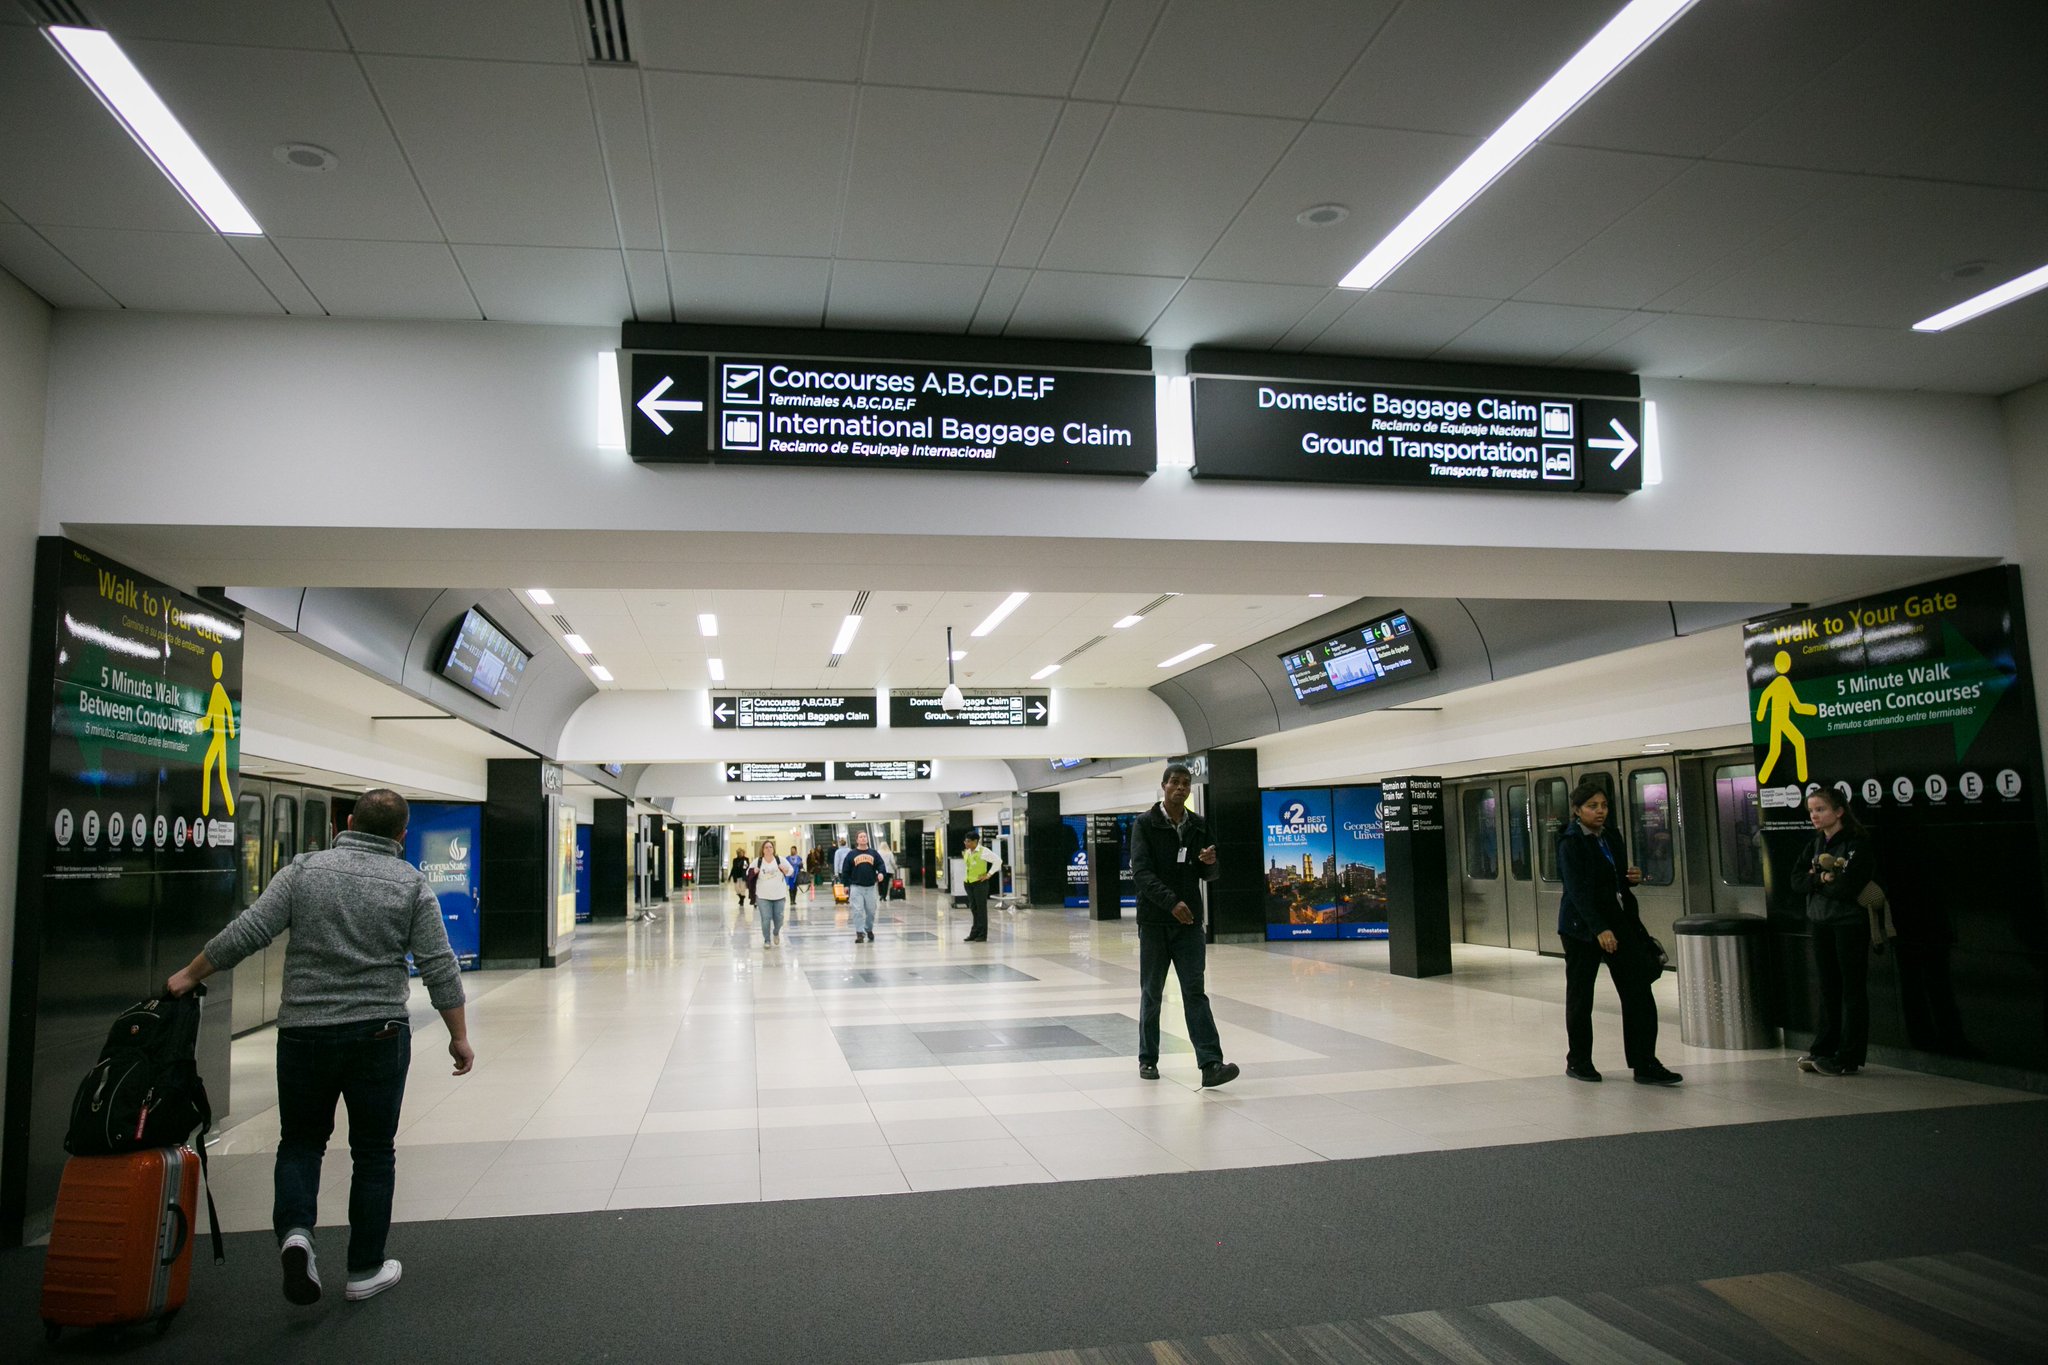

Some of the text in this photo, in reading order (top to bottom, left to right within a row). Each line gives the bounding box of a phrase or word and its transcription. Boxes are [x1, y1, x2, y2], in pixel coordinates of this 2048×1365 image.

[768, 366, 1055, 399] Concourses A,B,C,D,E,F
[769, 393, 916, 412] Terminales A,B,C,D,E,F
[1258, 387, 1537, 422] Domestic Baggage Claim
[768, 412, 1132, 446] International Baggage Claim
[1371, 419, 1537, 438] Reclamo de Equipaje Nacional
[769, 439, 996, 460] Reclamo de Equipaje Internacional
[1301, 433, 1538, 464] Ground Transportation
[1429, 464, 1538, 480] Transporte Terrestre
[98, 568, 138, 611] Walk
[143, 589, 158, 617] to
[1773, 619, 1818, 646] Walk
[1823, 617, 1844, 636] to
[1849, 604, 1899, 630] Your
[1904, 593, 1958, 618] Gate
[101, 666, 181, 707] 5 Minute Walk
[1837, 663, 1951, 696] 5 Minute Walk
[80, 690, 133, 722] Between
[754, 698, 800, 707] Concourses
[910, 697, 1009, 708] Domest ggage Claim
[1818, 696, 1882, 719] Between
[754, 712, 870, 722] International Baggage Claim
[1827, 721, 1833, 731] 5
[1833, 718, 1863, 731] minutos
[1863, 714, 1904, 728] caminando
[1906, 711, 1927, 724] entre
[85, 722, 91, 734] 5
[90, 724, 115, 739] minutos
[1382, 781, 1407, 790] Remain on
[1410, 780, 1432, 789] Remain
[1868, 783, 1877, 798] B
[1897, 781, 1908, 796] C
[1930, 779, 1942, 794] D
[1966, 776, 1976, 792] E
[2004, 774, 2015, 790] F
[1383, 791, 1395, 800] Train
[1411, 790, 1437, 799] Train for:
[1283, 803, 1326, 823] #2 BEST
[61, 815, 69, 836] F
[88, 816, 95, 837] E
[113, 818, 120, 837] D
[135, 819, 142, 838] C
[157, 820, 164, 838] B
[177, 821, 184, 839] A
[197, 822, 202, 839] T
[1267, 823, 1328, 835] TEACHING
[1353, 831, 1384, 840] Univers
[1294, 834, 1307, 842] U.S.
[1074, 852, 1087, 865] 2
[428, 872, 467, 885] University
